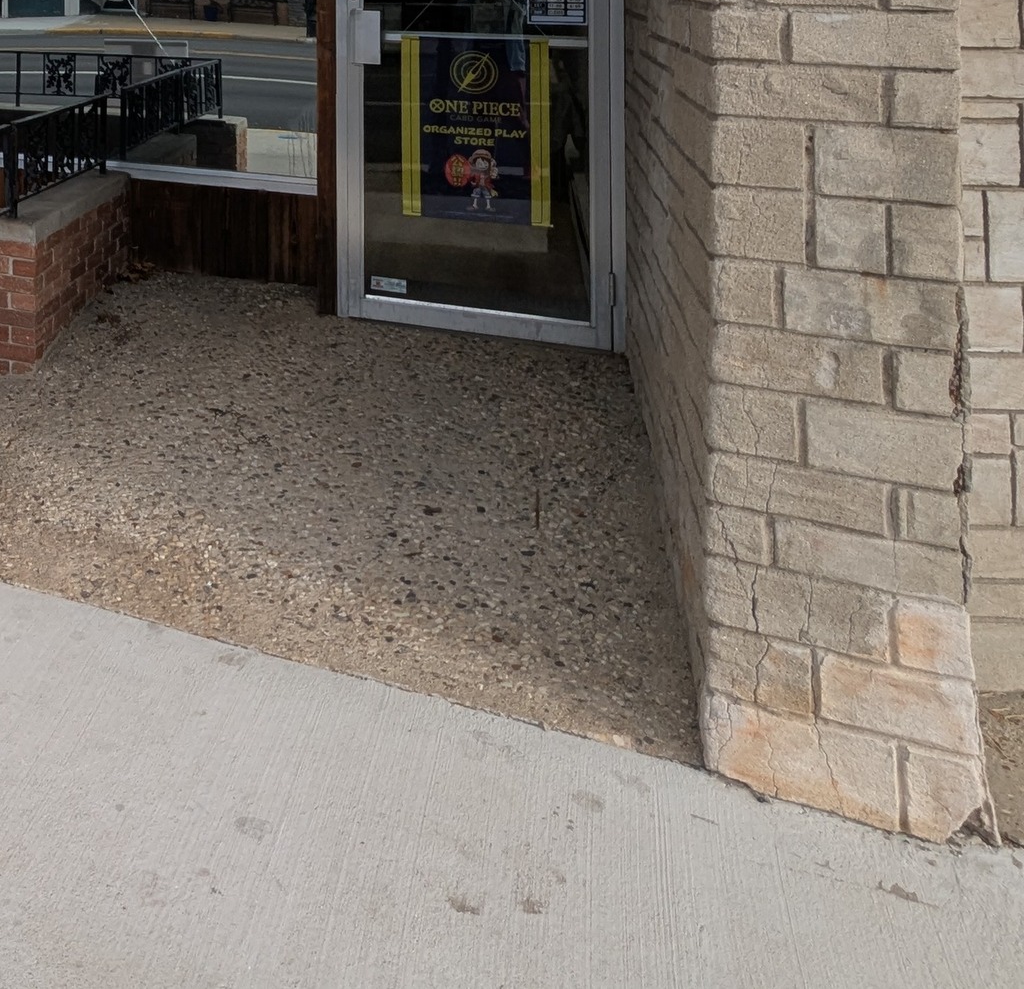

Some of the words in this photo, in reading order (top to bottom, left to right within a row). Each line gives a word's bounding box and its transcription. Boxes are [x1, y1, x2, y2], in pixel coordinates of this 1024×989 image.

[429, 98, 469, 114] ONE
[472, 100, 521, 117] PIECE
[450, 114, 474, 122] CARD
[423, 125, 492, 136] ORGANIZED
[494, 129, 527, 139] PLAY
[454, 137, 496, 147] STORE
